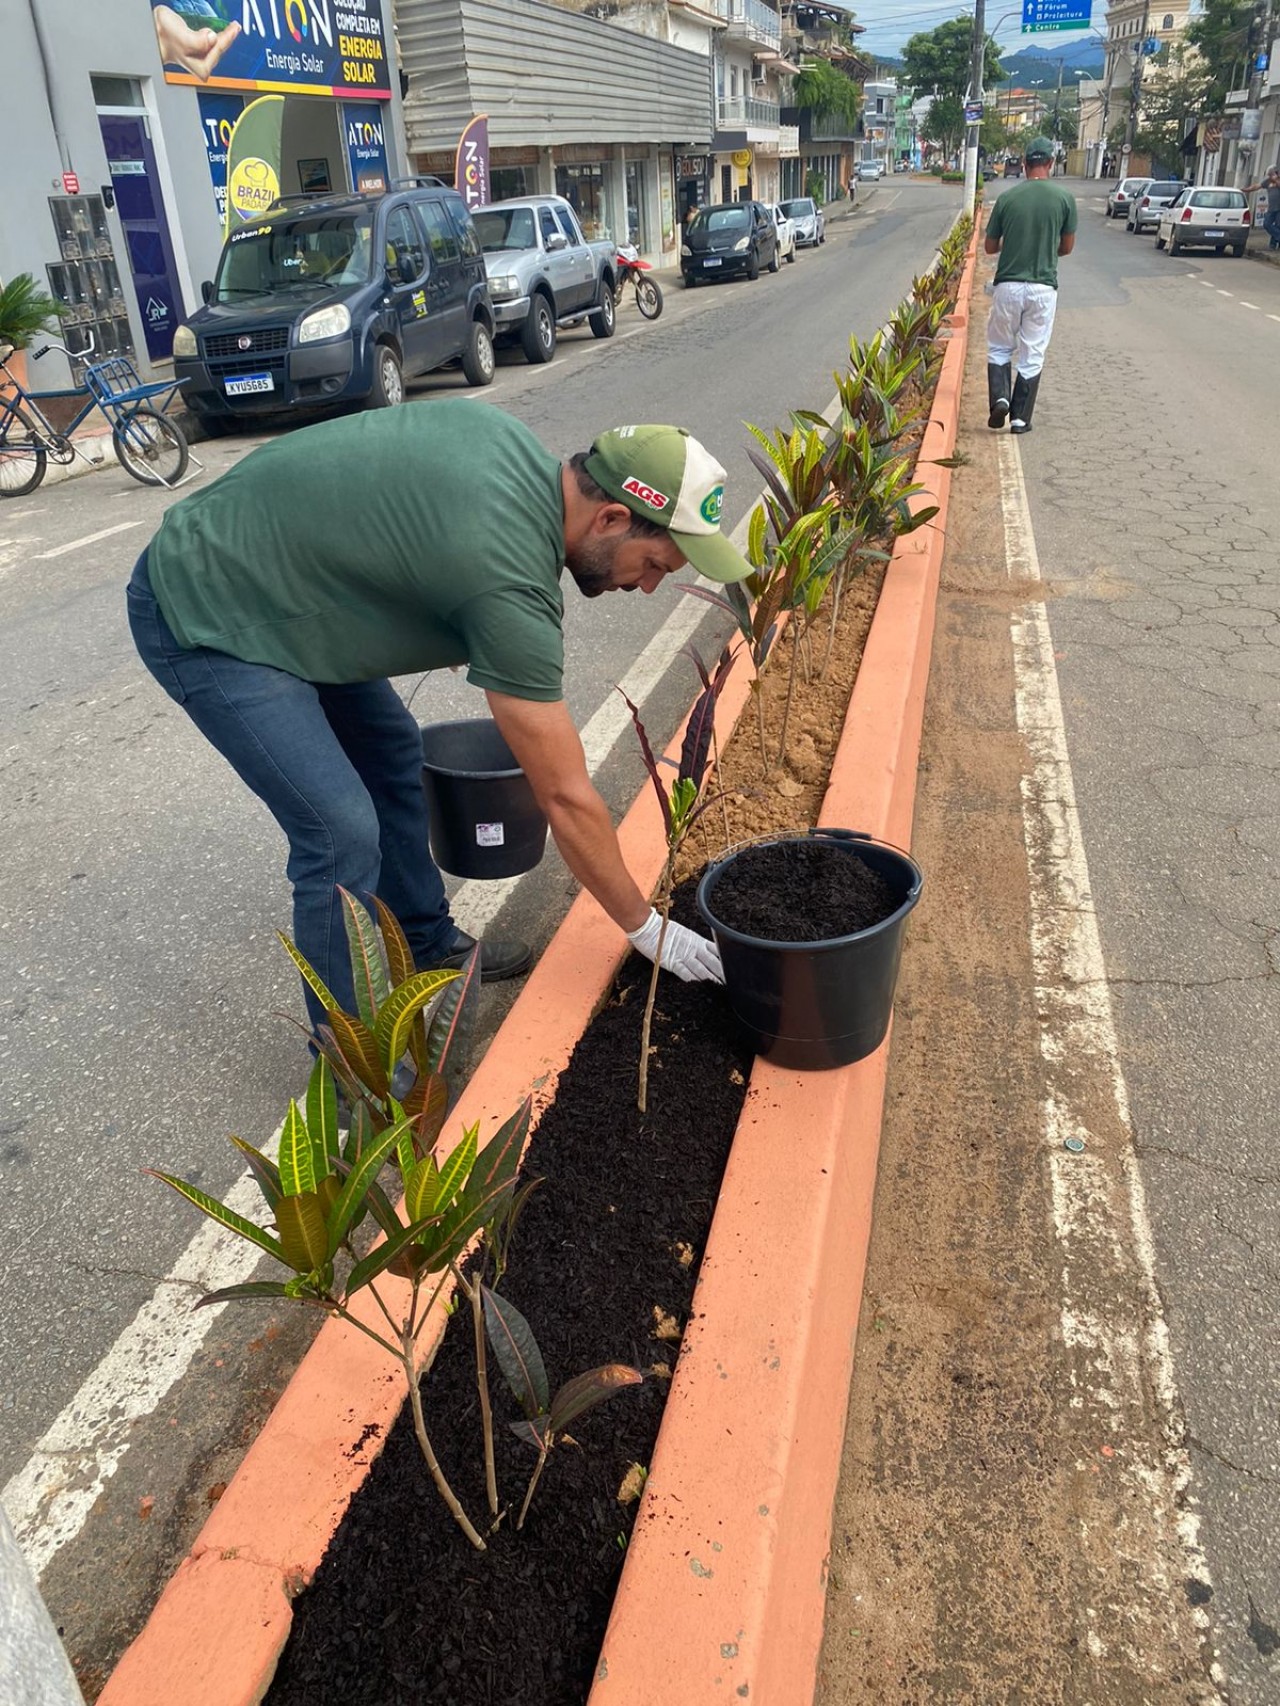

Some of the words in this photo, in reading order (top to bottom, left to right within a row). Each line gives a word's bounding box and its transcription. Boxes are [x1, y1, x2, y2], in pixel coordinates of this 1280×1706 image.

[1044, 3, 1067, 11] Fórum
[336, 12, 370, 34] COMPLETA
[370, 18, 381, 35] EM
[339, 35, 383, 60] ENERGIA
[266, 48, 301, 75] Energia
[302, 53, 324, 73] Solar
[343, 61, 376, 83] SOLAR
[349, 122, 384, 146] ATON
[357, 148, 370, 160] Energia
[370, 149, 380, 158] Solar
[624, 480, 667, 508] AGS
